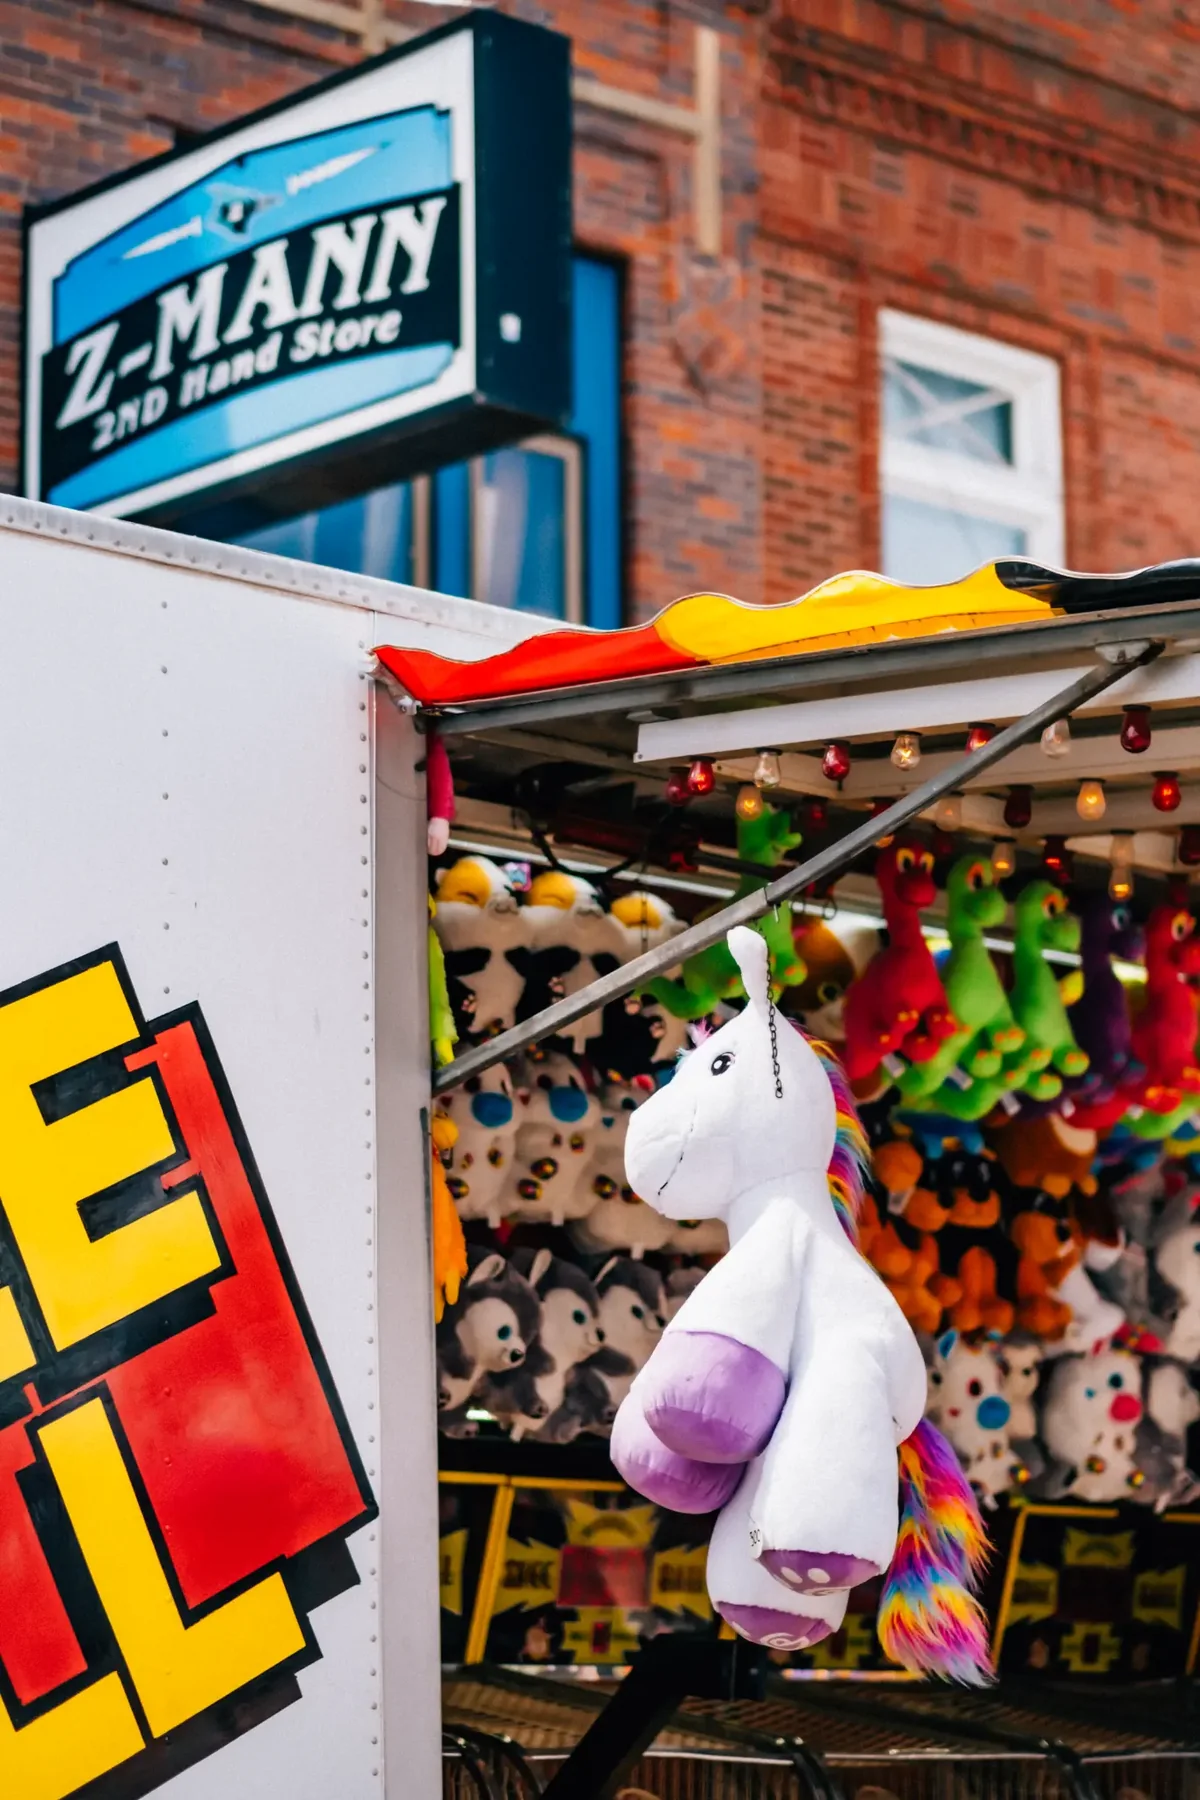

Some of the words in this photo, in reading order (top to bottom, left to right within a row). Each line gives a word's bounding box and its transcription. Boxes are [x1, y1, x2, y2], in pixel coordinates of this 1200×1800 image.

[56, 197, 447, 430] Z-MANN
[91, 385, 169, 452] 2ND
[179, 330, 284, 409] Hand
[289, 308, 403, 364] Store
